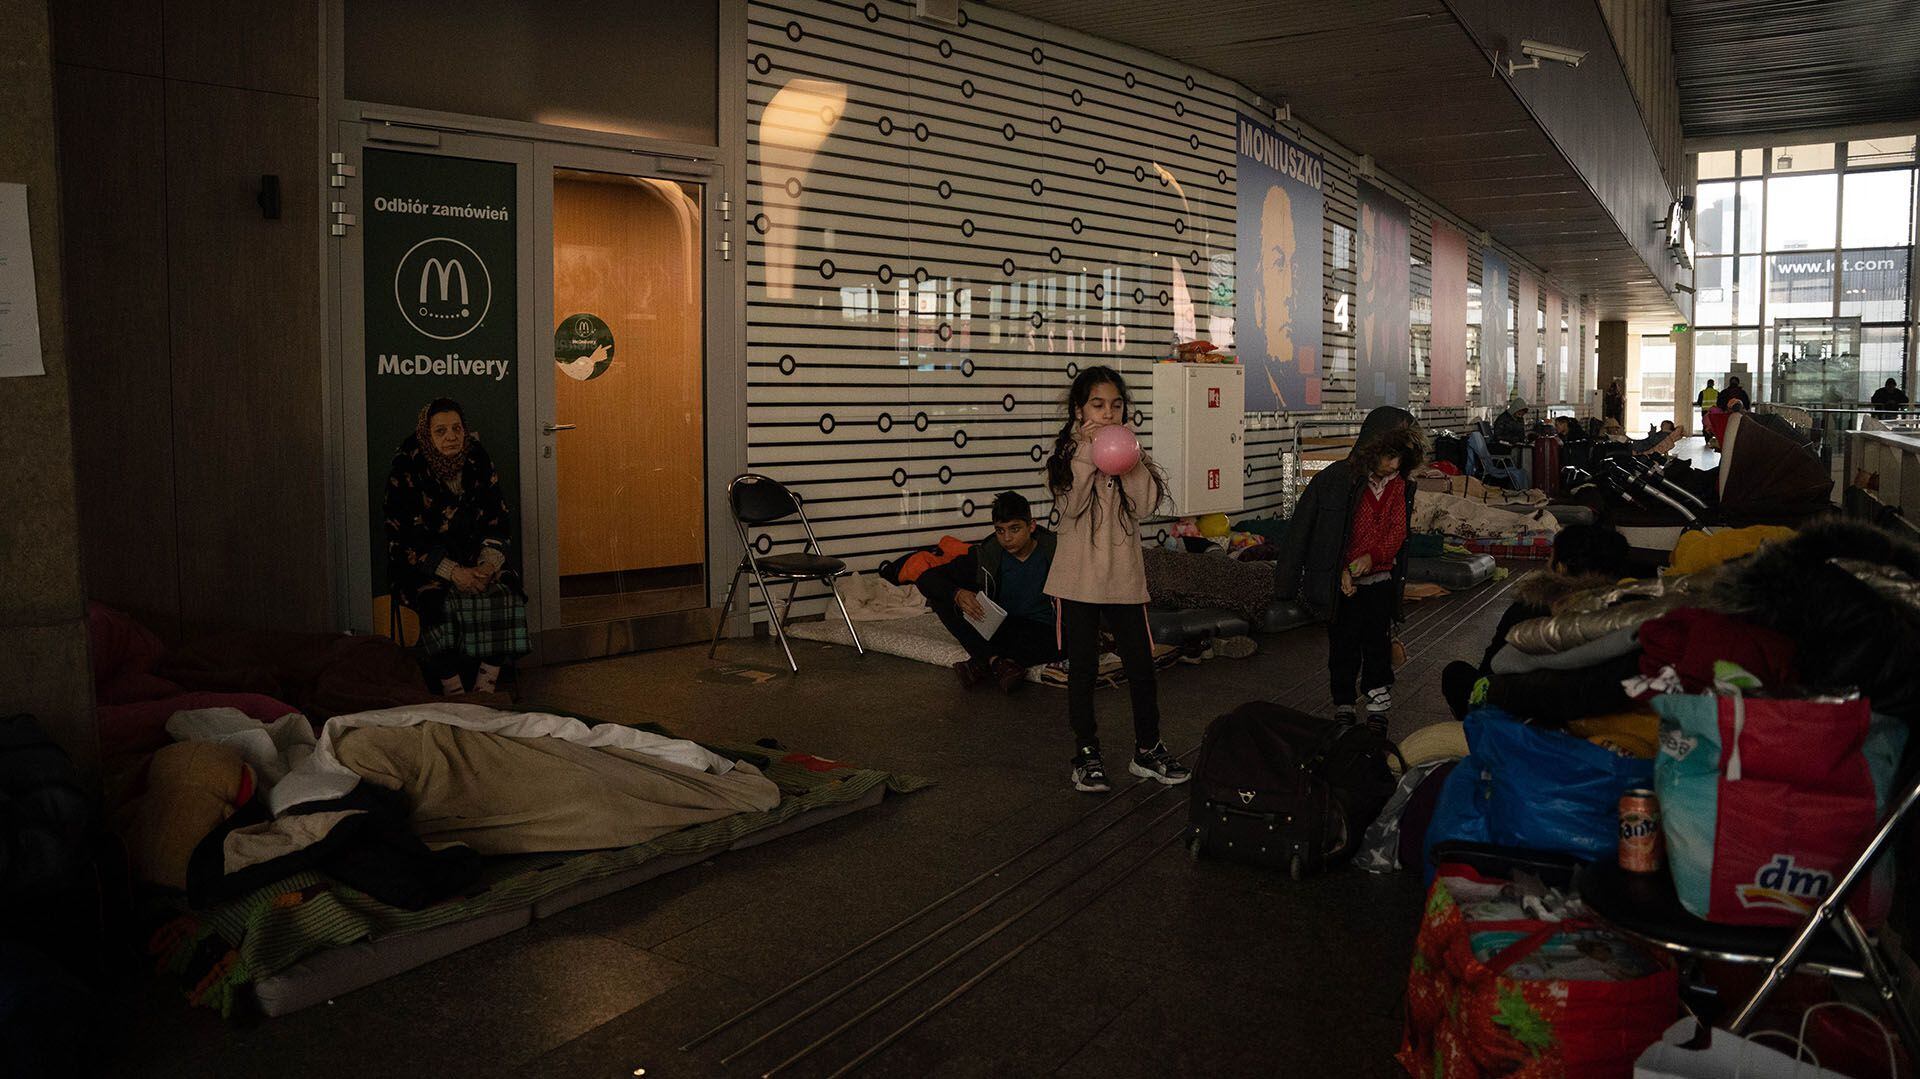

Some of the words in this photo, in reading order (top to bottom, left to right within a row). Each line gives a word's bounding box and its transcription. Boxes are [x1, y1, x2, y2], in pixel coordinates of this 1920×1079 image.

[1240, 119, 1322, 190] MONIUSZKO
[374, 197, 429, 214] Odbiór
[432, 204, 509, 221] zamówień
[377, 353, 509, 381] McDelivery
[1759, 859, 1828, 896] dm
